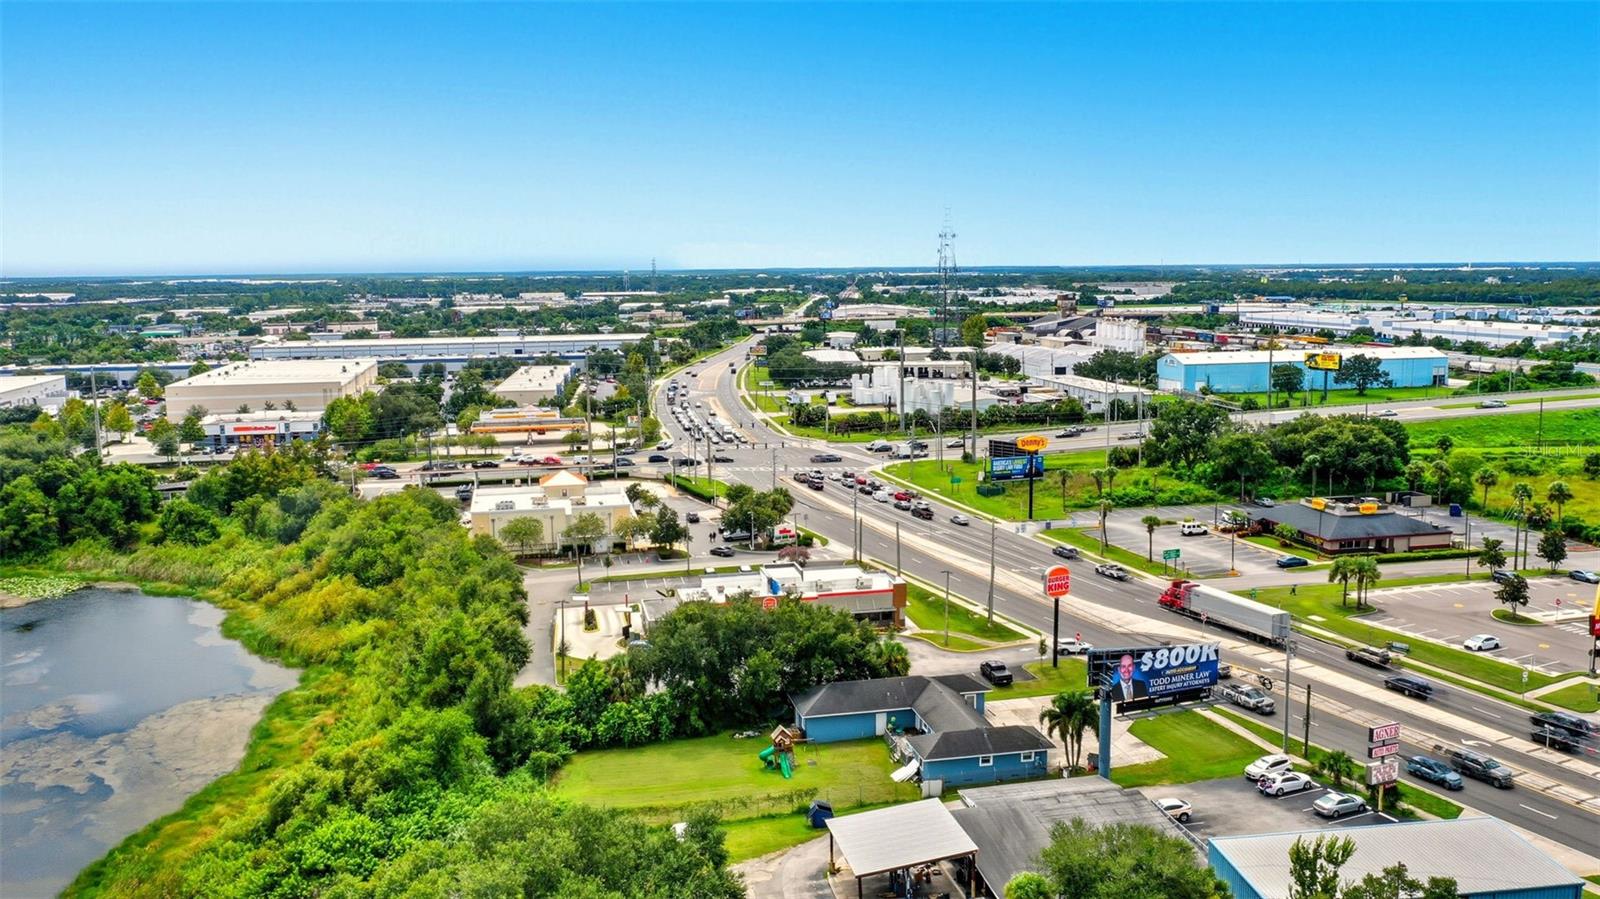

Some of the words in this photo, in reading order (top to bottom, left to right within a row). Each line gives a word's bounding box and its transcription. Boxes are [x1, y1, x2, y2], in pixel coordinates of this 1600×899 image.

[1021, 438, 1045, 447] Denny's
[1048, 575, 1069, 583] BURGER
[1047, 582, 1069, 592] KING
[1140, 644, 1217, 672] $800K
[1149, 676, 1171, 686] TODD
[1171, 673, 1194, 683] MINER
[1195, 671, 1210, 679] LAW
[1149, 685, 1166, 693] EXPERT
[1166, 682, 1183, 690] INJURY
[1183, 678, 1210, 688] ATTORNEYS
[1375, 727, 1399, 739] AGNER
[1374, 747, 1384, 756] AUTO
[1385, 744, 1399, 754] PARTS
